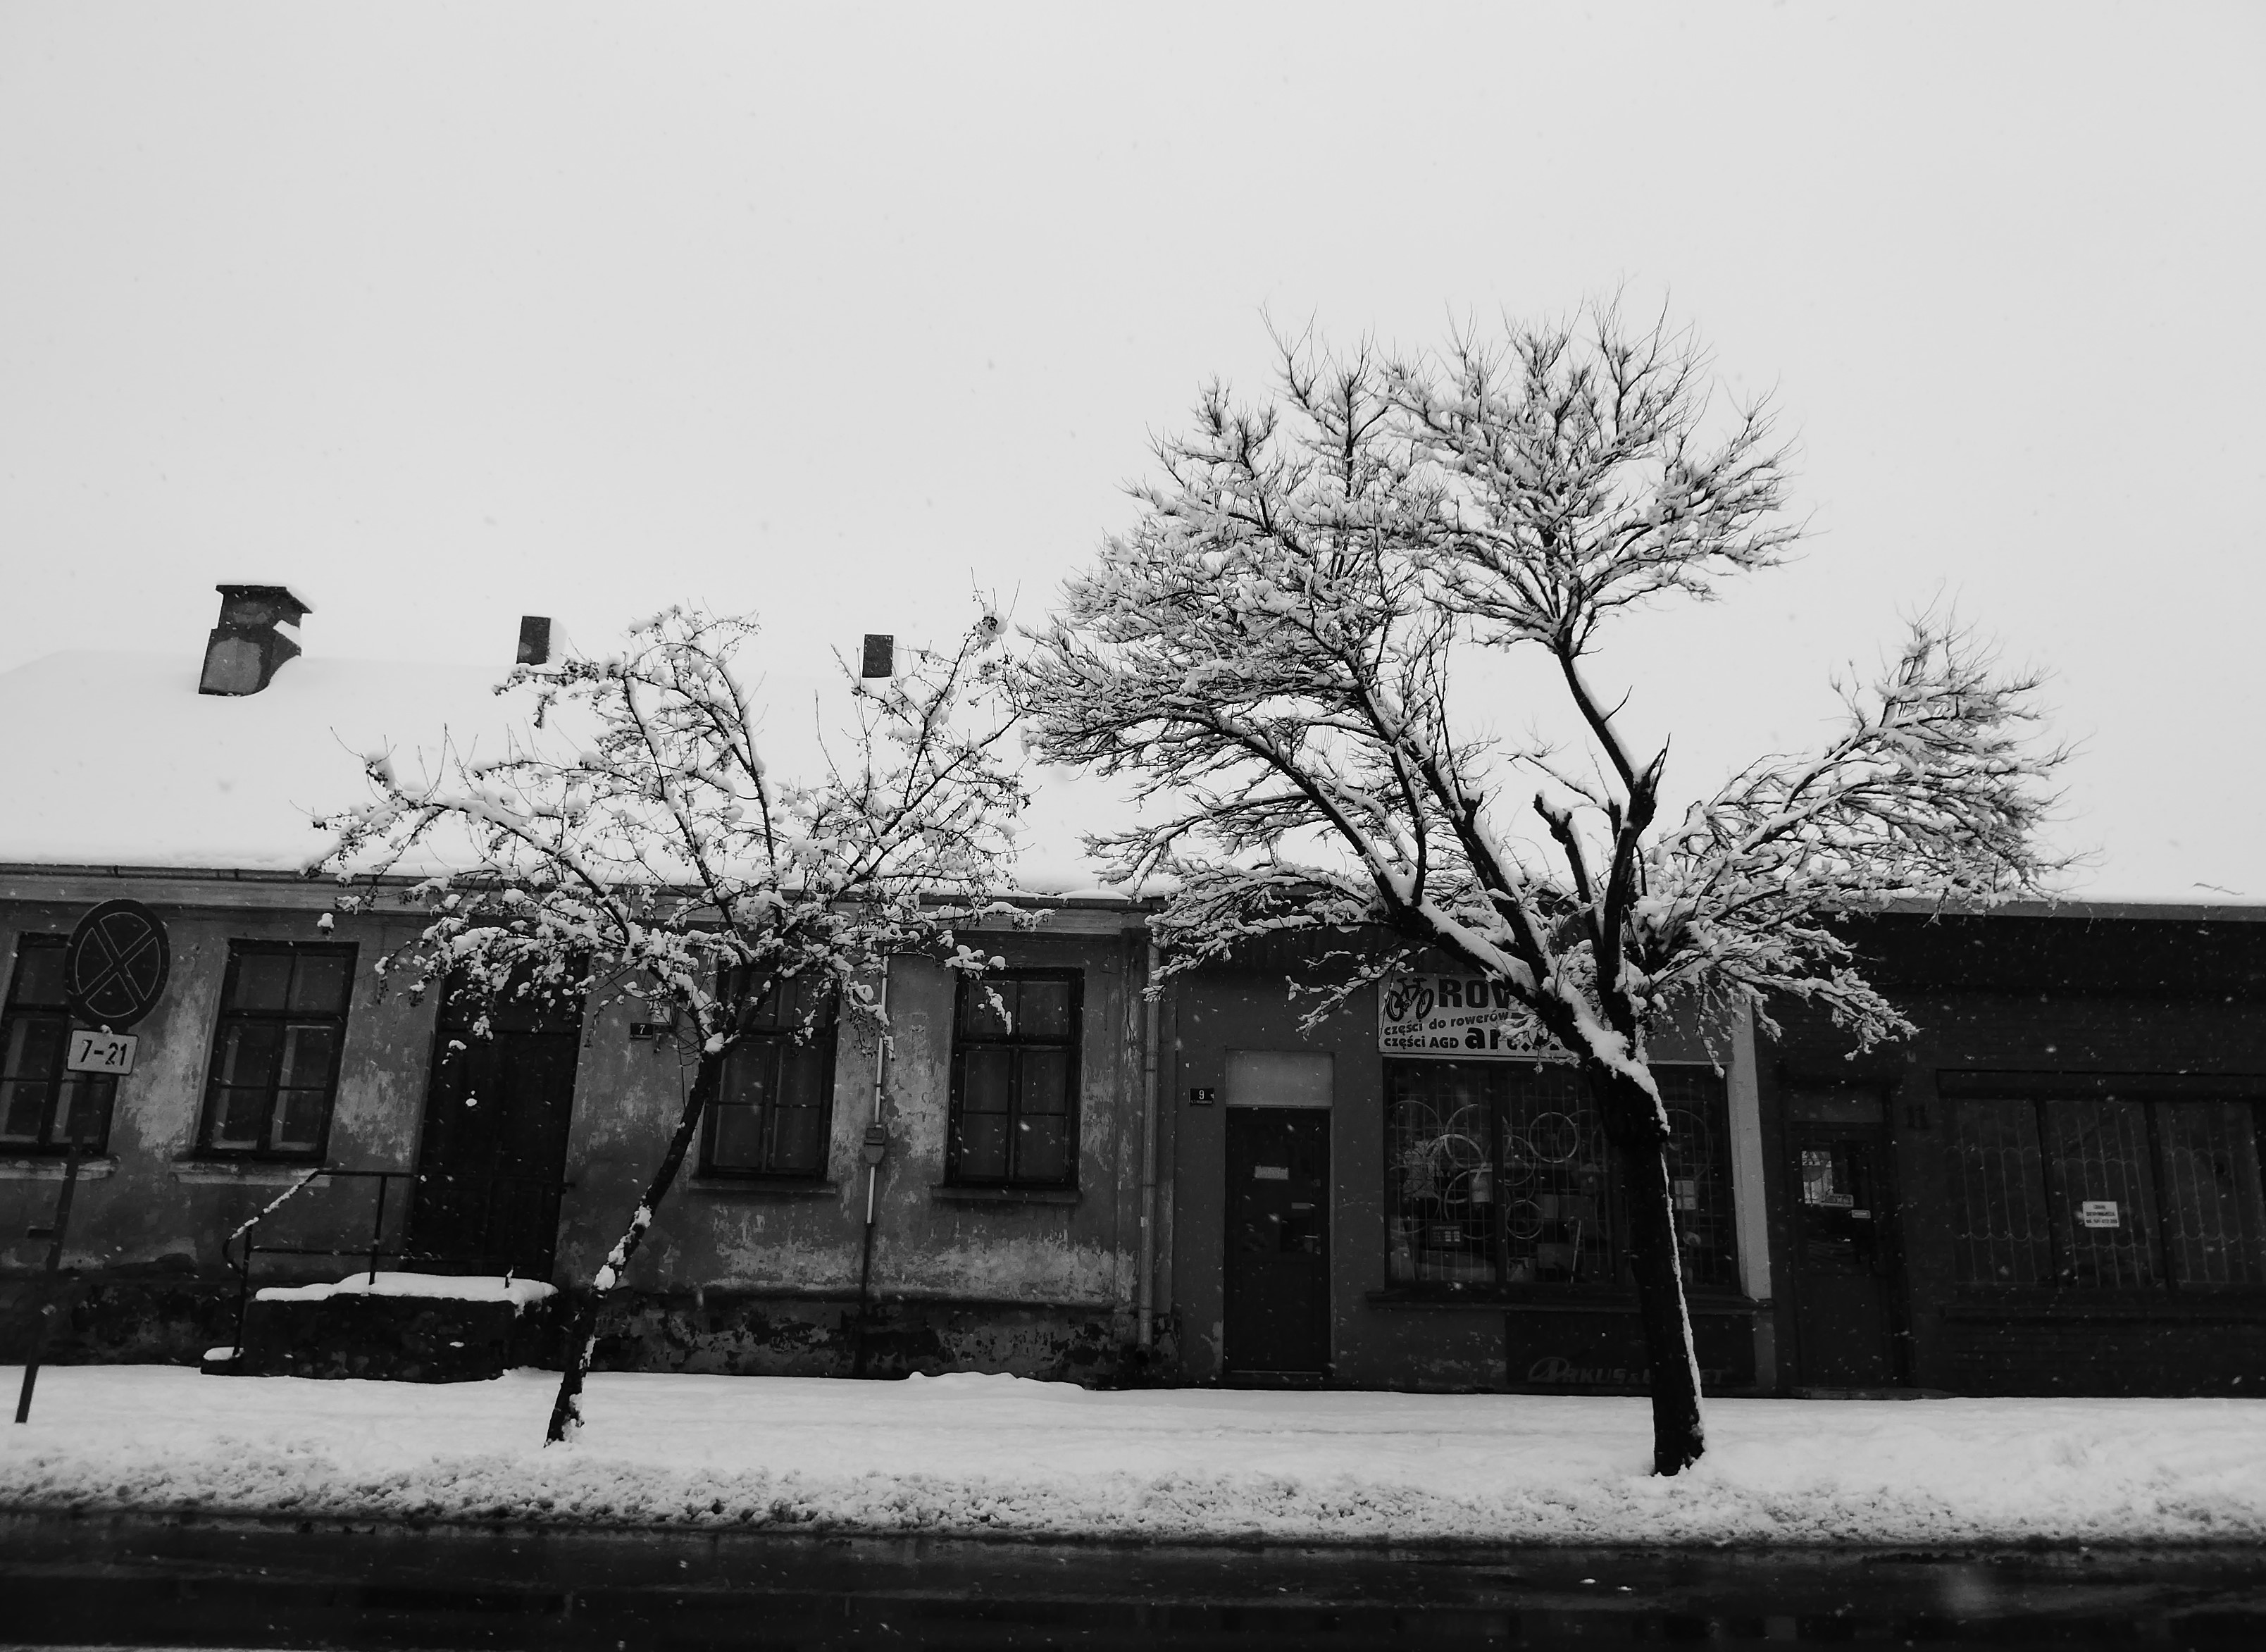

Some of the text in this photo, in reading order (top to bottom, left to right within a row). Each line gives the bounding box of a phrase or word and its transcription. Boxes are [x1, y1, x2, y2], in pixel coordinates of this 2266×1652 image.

[640, 1024, 646, 1034] 7
[1384, 1010, 1509, 1036] części do rowerów
[1384, 1036, 1426, 1049] części
[1429, 1037, 1459, 1048] AGD
[80, 1039, 127, 1066] 7-21
[1199, 1090, 1204, 1100] 9
